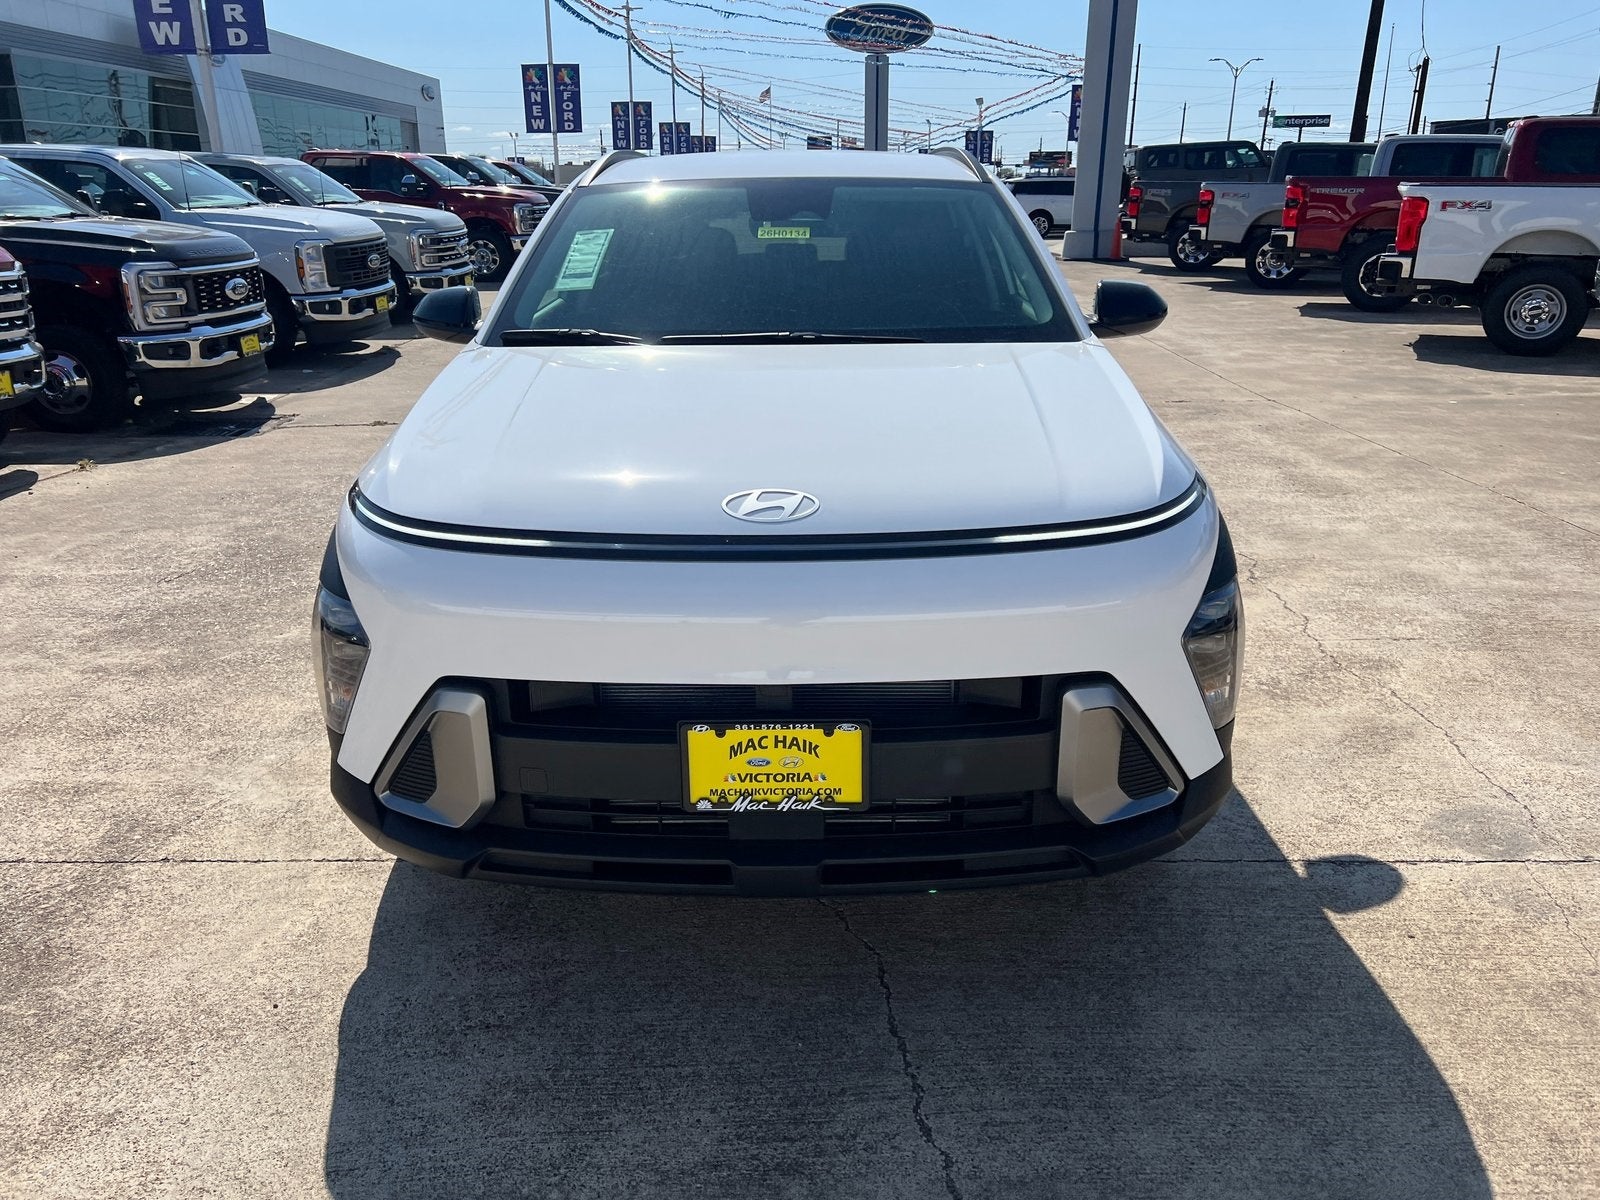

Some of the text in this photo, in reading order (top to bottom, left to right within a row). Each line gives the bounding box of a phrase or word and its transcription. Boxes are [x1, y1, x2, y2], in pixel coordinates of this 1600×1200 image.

[850, 14, 909, 41] Ford
[530, 91, 545, 130] NEW
[562, 91, 575, 131] FORD
[1278, 116, 1330, 126] enterprise
[616, 120, 627, 148] NEW
[639, 120, 648, 149] FORD
[1440, 200, 1493, 210] FX4
[759, 229, 808, 237] 26H0134
[729, 735, 820, 760] MAC HAIK
[737, 772, 814, 783] VICTORIA
[709, 787, 842, 797] MACHAIKVICTORIA.COM
[730, 795, 826, 812] Mac Haik
